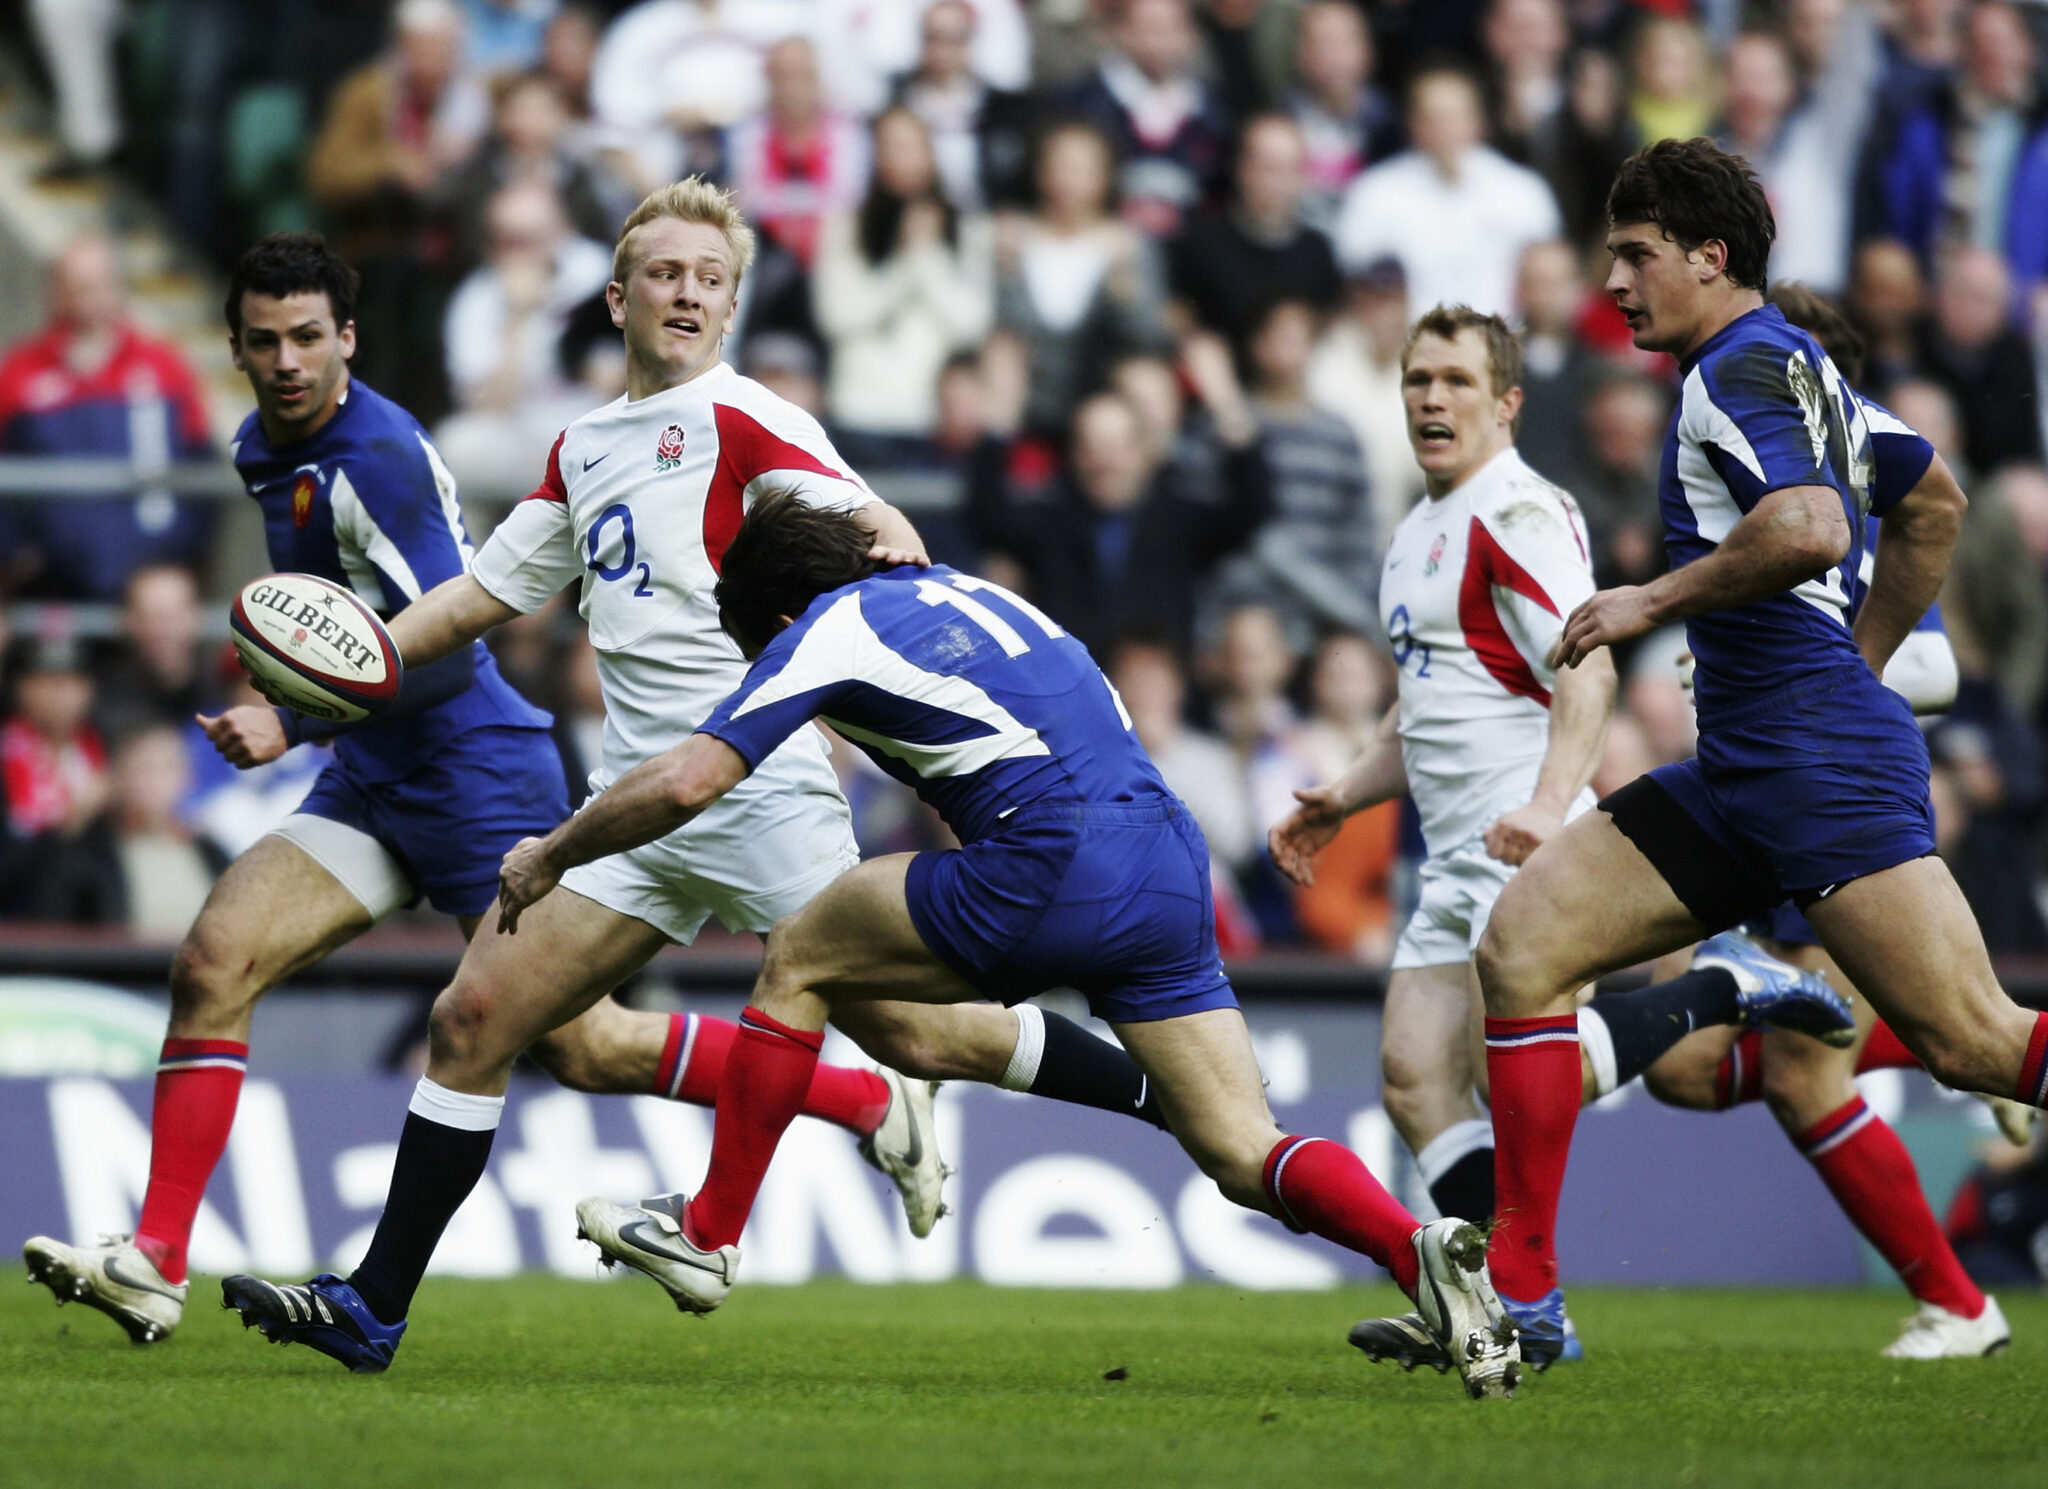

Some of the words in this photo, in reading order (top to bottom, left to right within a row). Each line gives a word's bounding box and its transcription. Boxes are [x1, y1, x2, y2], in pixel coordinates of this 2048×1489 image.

[250, 584, 378, 672] GILBERT
[913, 573, 1067, 659] 11
[46, 1078, 1425, 1292] NatWes
